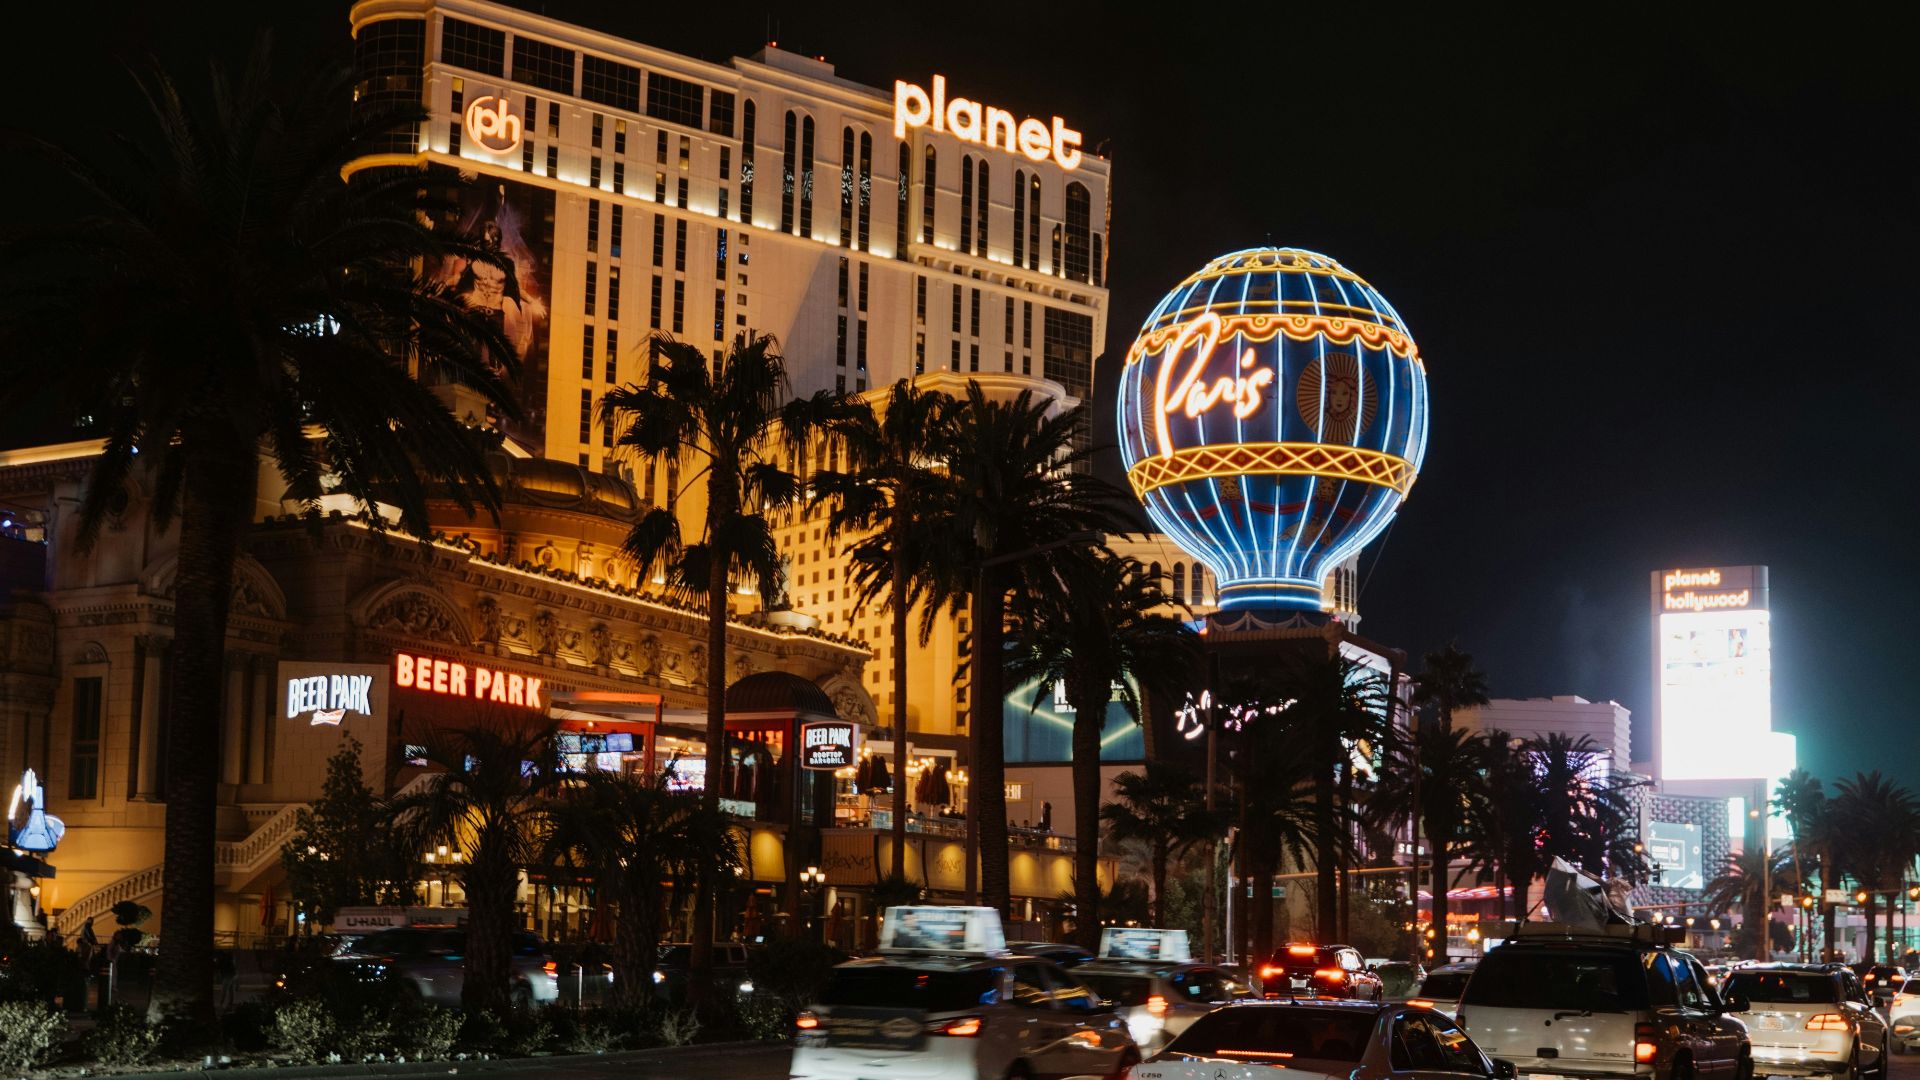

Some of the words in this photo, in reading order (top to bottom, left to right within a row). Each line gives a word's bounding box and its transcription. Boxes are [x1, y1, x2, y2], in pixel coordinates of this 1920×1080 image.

[474, 98, 520, 143] ph
[893, 74, 1083, 170] planet
[1154, 311, 1274, 460] Paris
[1664, 569, 1721, 591] planet
[1664, 590, 1749, 611] hollywood
[287, 675, 328, 718] BEER
[331, 674, 373, 716] PARK
[396, 652, 467, 696] BEER
[474, 667, 543, 709] PARK
[806, 728, 828, 748] BEER
[828, 727, 851, 748] PARK
[346, 917, 395, 927] U-HAUL
